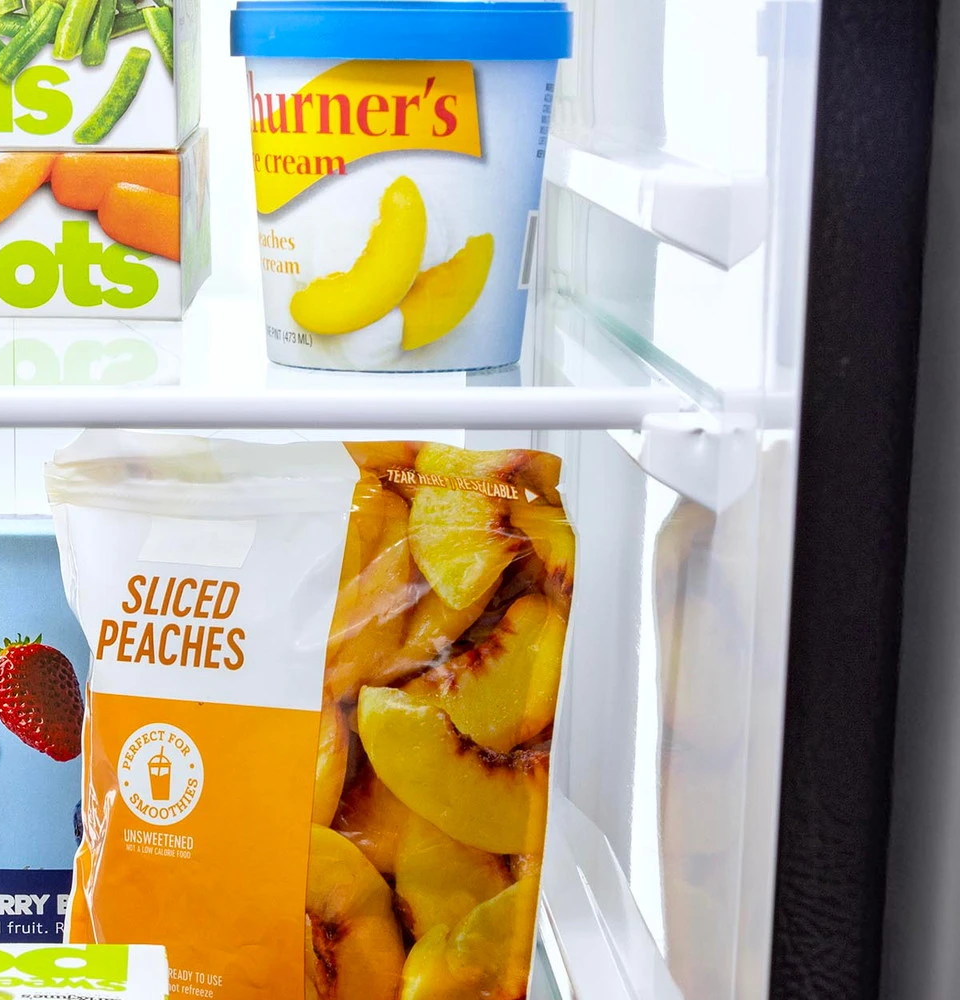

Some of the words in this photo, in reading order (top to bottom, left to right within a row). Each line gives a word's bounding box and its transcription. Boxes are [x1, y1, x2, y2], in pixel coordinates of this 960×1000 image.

[247, 70, 458, 138] hurner's
[264, 153, 348, 176] cream
[259, 229, 296, 251] eaches
[283, 329, 296, 344] (473
[298, 332, 313, 347] ML)
[386, 469, 416, 485] TEAR
[122, 574, 241, 620] SLICED
[95, 619, 246, 671] PEACHES
[122, 730, 165, 770] PERFECT
[167, 732, 190, 757] FOR
[129, 777, 198, 820] SMOOTHIES
[123, 828, 194, 851] UNSWEETENED
[142, 846, 153, 854] LOW
[7, 921, 49, 934] fruit.
[168, 967, 193, 981] READY
[195, 972, 205, 984] TO
[207, 974, 223, 986] USE
[181, 984, 214, 998] refreeze
